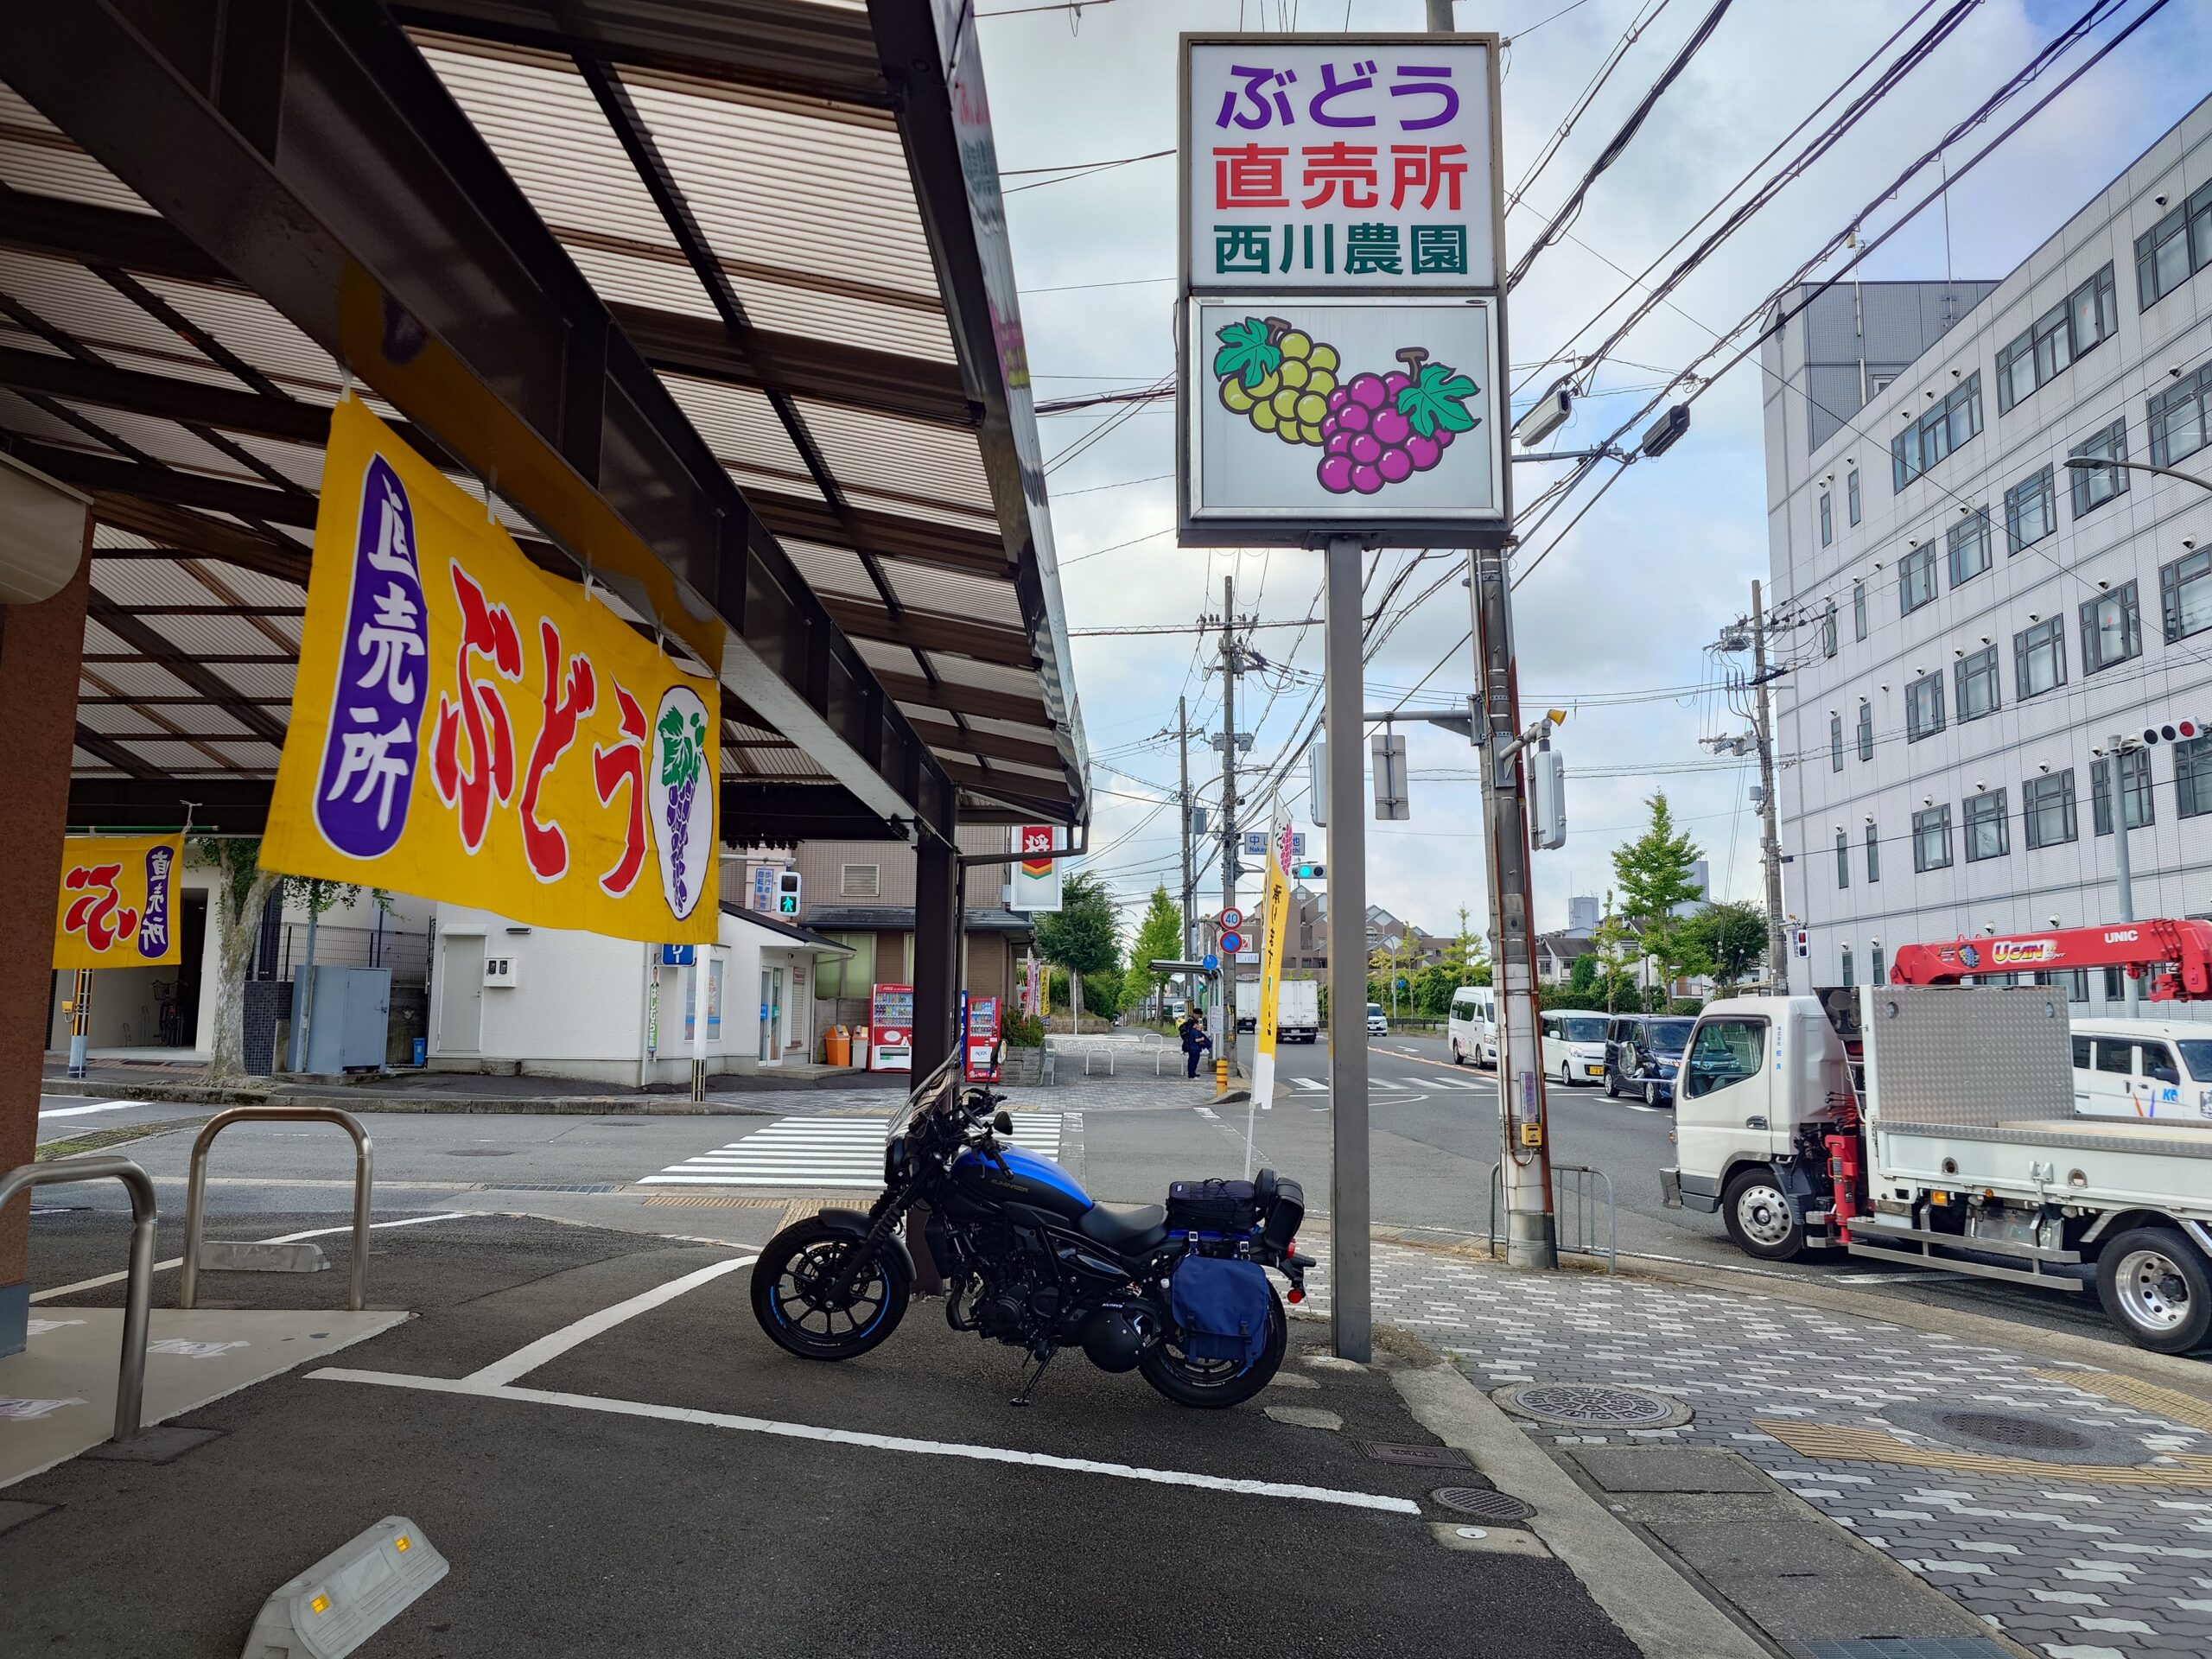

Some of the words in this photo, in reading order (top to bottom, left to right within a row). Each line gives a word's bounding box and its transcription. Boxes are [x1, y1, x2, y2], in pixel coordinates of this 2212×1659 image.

[1215, 60, 1459, 130] ぶどう
[1212, 141, 1468, 211] 直売所
[1213, 222, 1468, 275] 西川農園
[326, 474, 425, 831] 直売所
[430, 557, 647, 899] ぶどう
[1225, 913, 1238, 925] 40
[2104, 930, 2139, 944] UNIC
